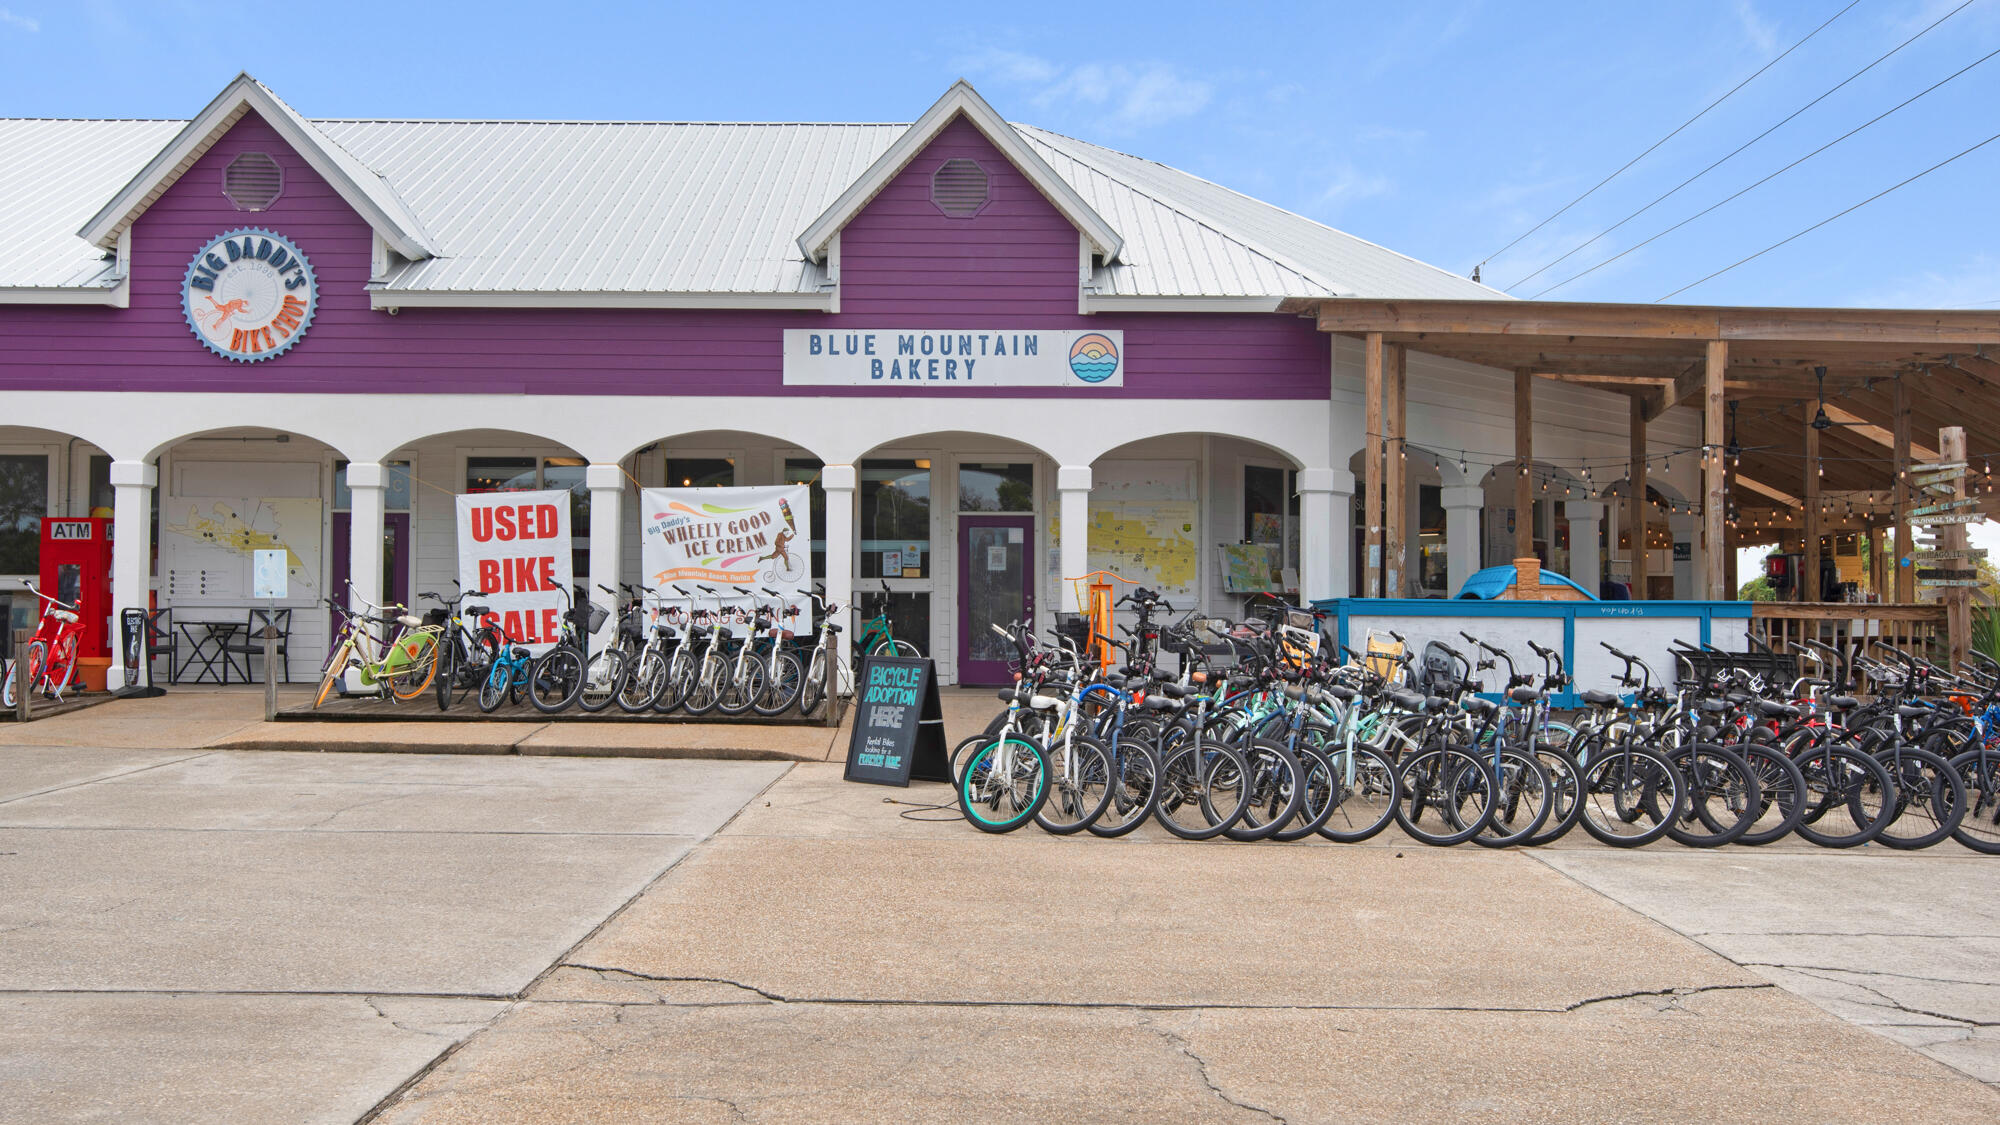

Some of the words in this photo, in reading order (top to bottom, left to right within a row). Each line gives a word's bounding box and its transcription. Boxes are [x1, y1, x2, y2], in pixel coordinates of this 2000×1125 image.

[191, 252, 227, 292] BIG
[224, 237, 306, 290] DADDY'S
[230, 325, 276, 353] BIKE
[271, 295, 307, 338] SHOP
[809, 334, 877, 356] BLUE
[898, 334, 1040, 356] MOUNTAIN
[870, 358, 977, 380] BAKERY
[54, 523, 90, 538] ATM
[470, 504, 559, 543] USED
[648, 525, 662, 536] Big
[661, 515, 691, 530] Daddy's
[663, 522, 722, 546] WHEELY
[728, 510, 771, 536] GOOD
[684, 541, 712, 559] ICE
[716, 531, 768, 554] CREAM
[479, 556, 557, 594] BIKE
[678, 570, 707, 579] Mountain
[730, 574, 751, 582] Florida
[480, 608, 559, 647] SALE
[870, 667, 921, 687] BICYCLE
[864, 687, 918, 706] ADOPTION
[869, 706, 905, 729] HERE
[867, 737, 881, 745] Rental
[882, 738, 895, 747] Bikes
